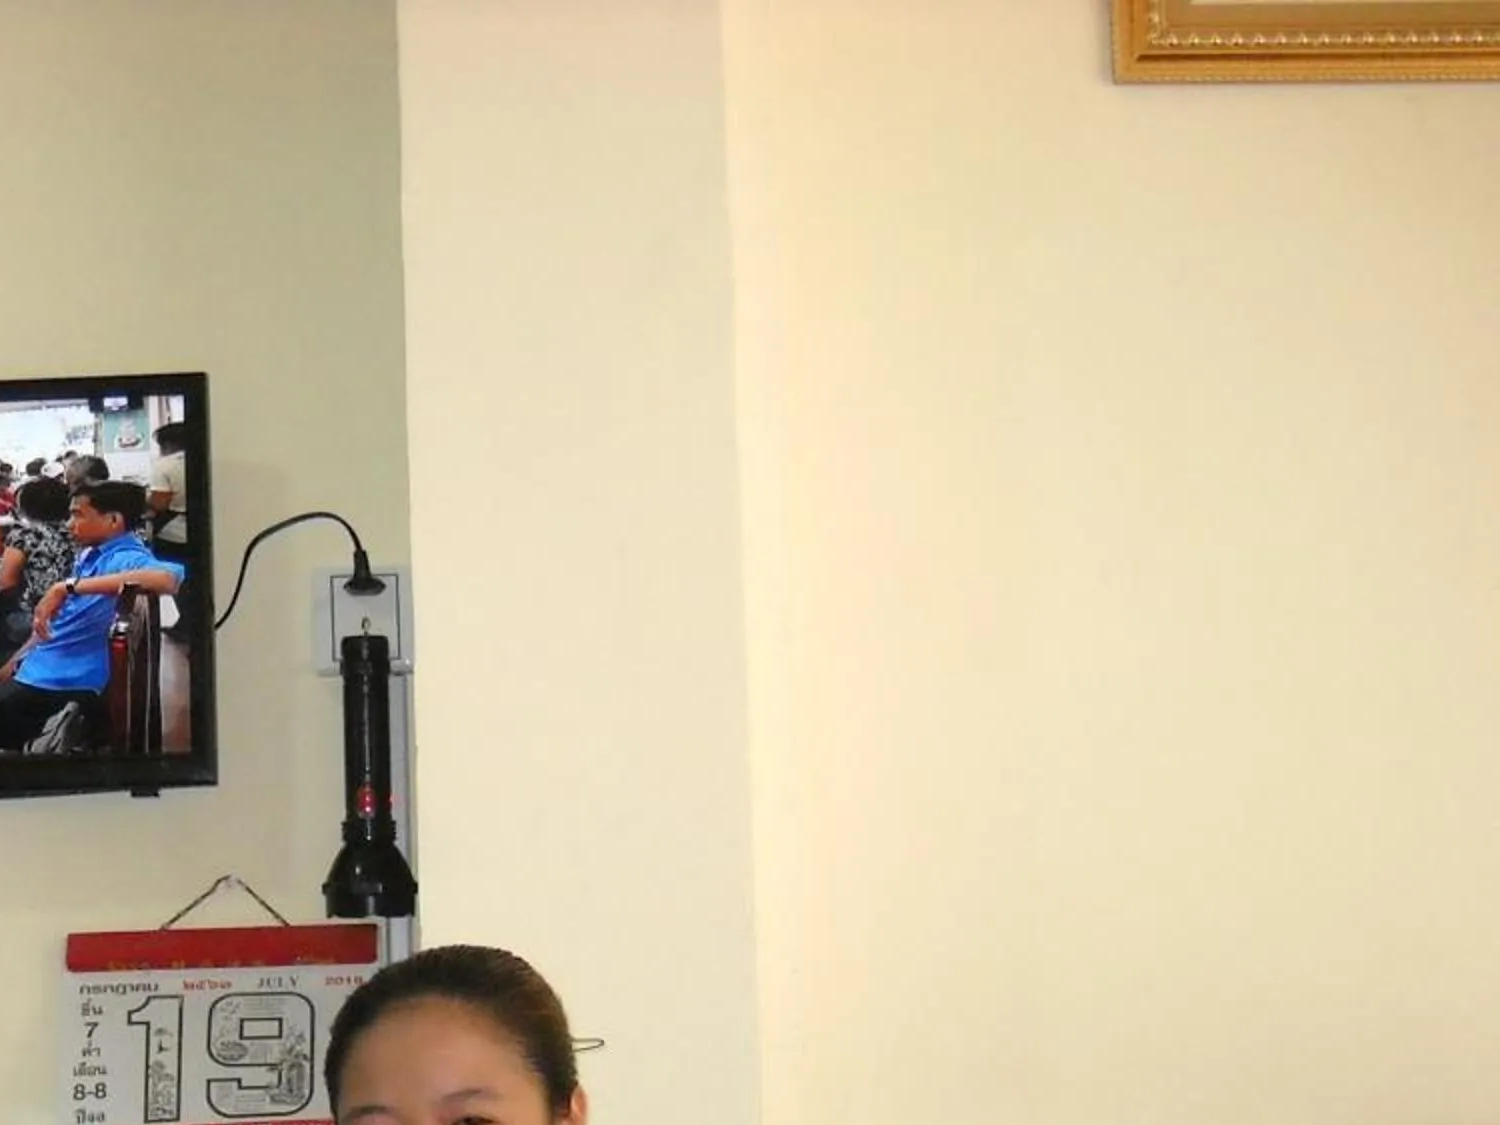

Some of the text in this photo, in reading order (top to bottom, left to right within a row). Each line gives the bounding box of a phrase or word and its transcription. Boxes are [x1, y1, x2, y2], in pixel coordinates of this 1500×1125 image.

[257, 975, 300, 988] JULY
[84, 1022, 99, 1038] 7
[127, 992, 315, 1123] 19
[73, 1082, 107, 1101] 8-8
